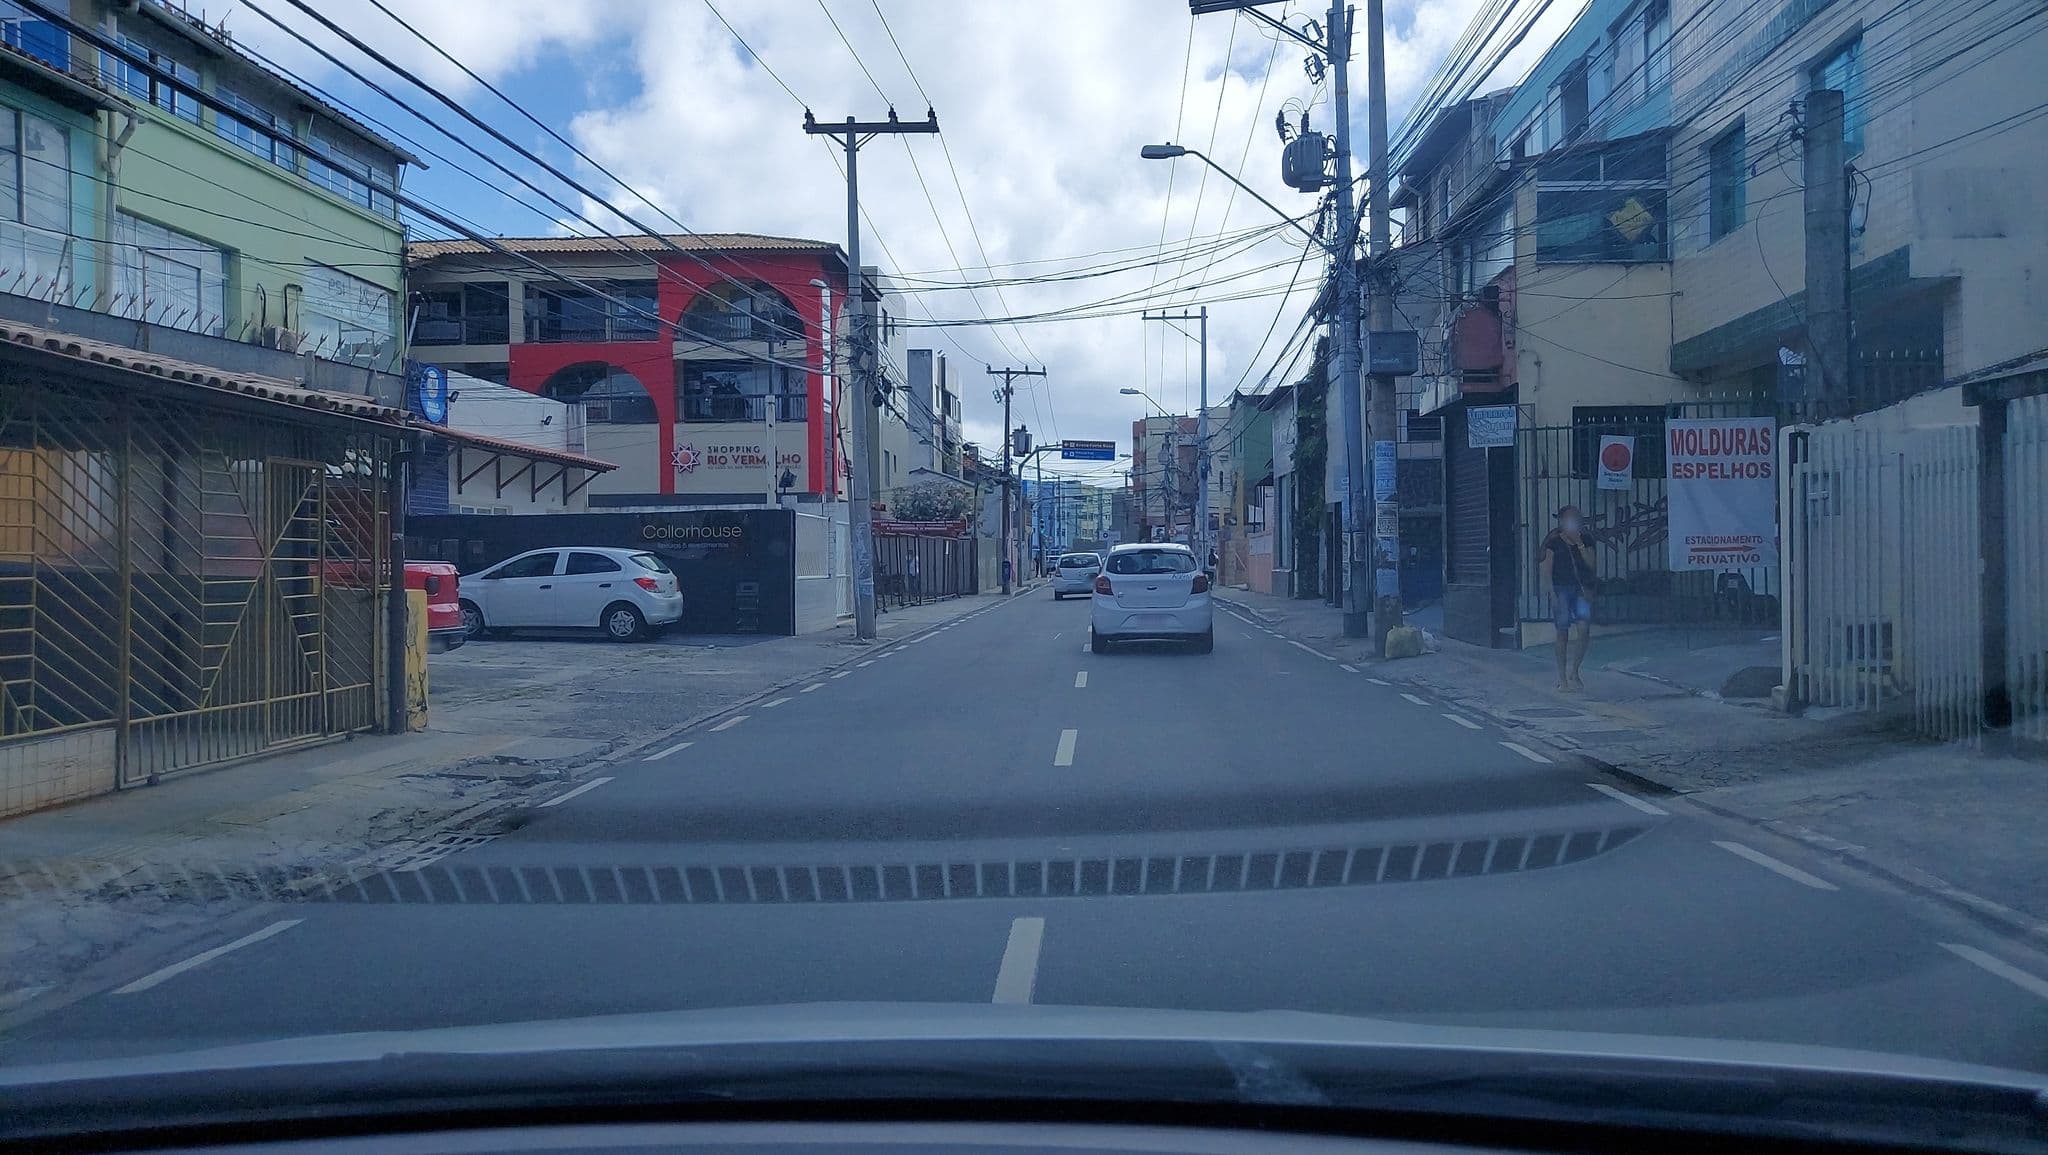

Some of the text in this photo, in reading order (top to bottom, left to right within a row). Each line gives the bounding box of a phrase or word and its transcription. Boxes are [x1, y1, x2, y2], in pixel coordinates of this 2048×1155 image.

[1671, 427, 1771, 457] MOLDURAS
[707, 446, 760, 454] SHOPPING
[707, 453, 802, 465] RIO VERMLHO
[1672, 462, 1772, 480] ESPELHOS
[643, 524, 742, 539] Collorhouse
[1685, 535, 1764, 545] ESTACIONAMENTO
[1688, 553, 1761, 565] PRIVATIVO
